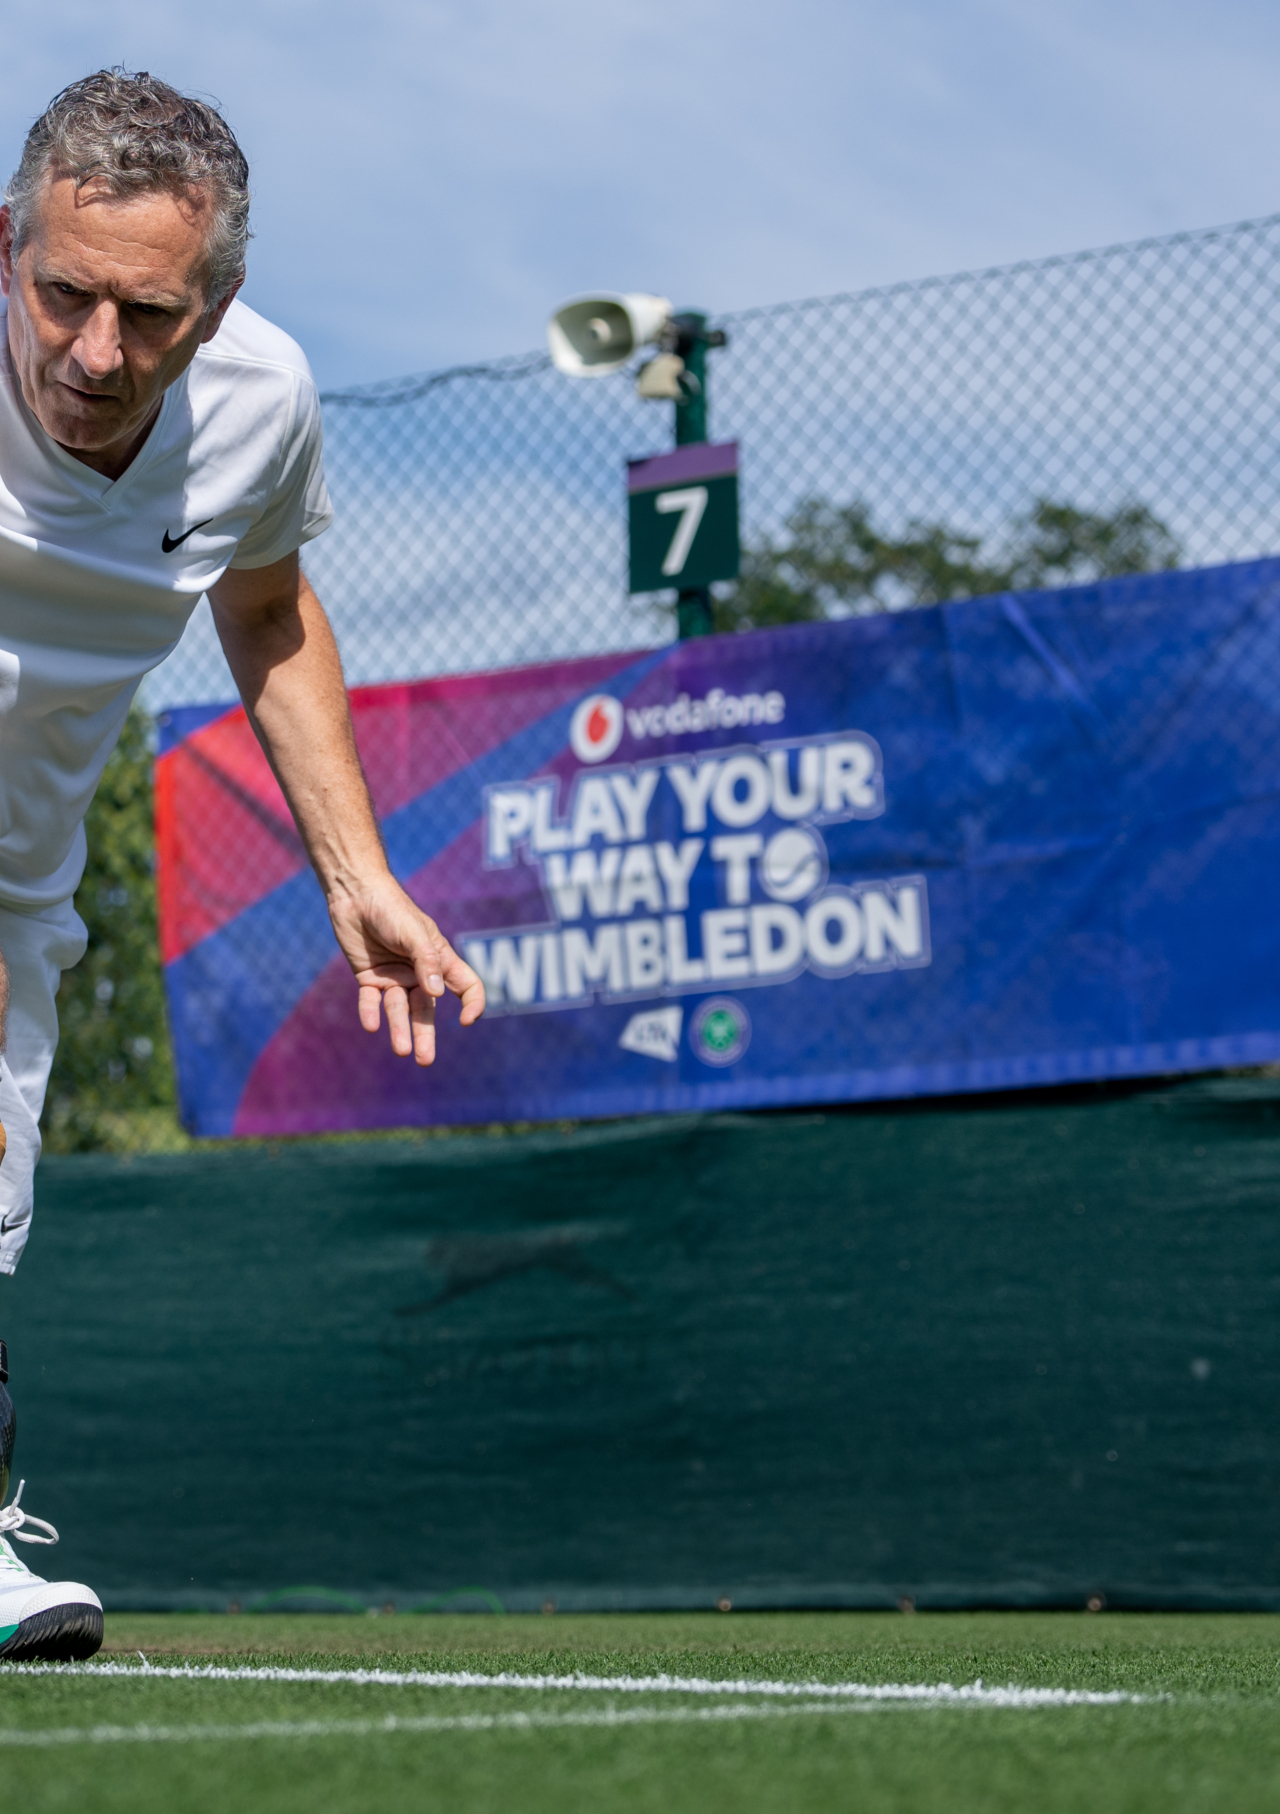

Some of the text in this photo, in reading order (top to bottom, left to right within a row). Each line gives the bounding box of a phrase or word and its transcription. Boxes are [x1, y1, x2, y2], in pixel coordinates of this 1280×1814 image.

[655, 486, 709, 576] 7
[625, 687, 786, 740] vodafone
[487, 741, 876, 858] PLAY YOUR
[547, 839, 705, 922] WAY
[466, 885, 923, 1004] WIMBLEDON
